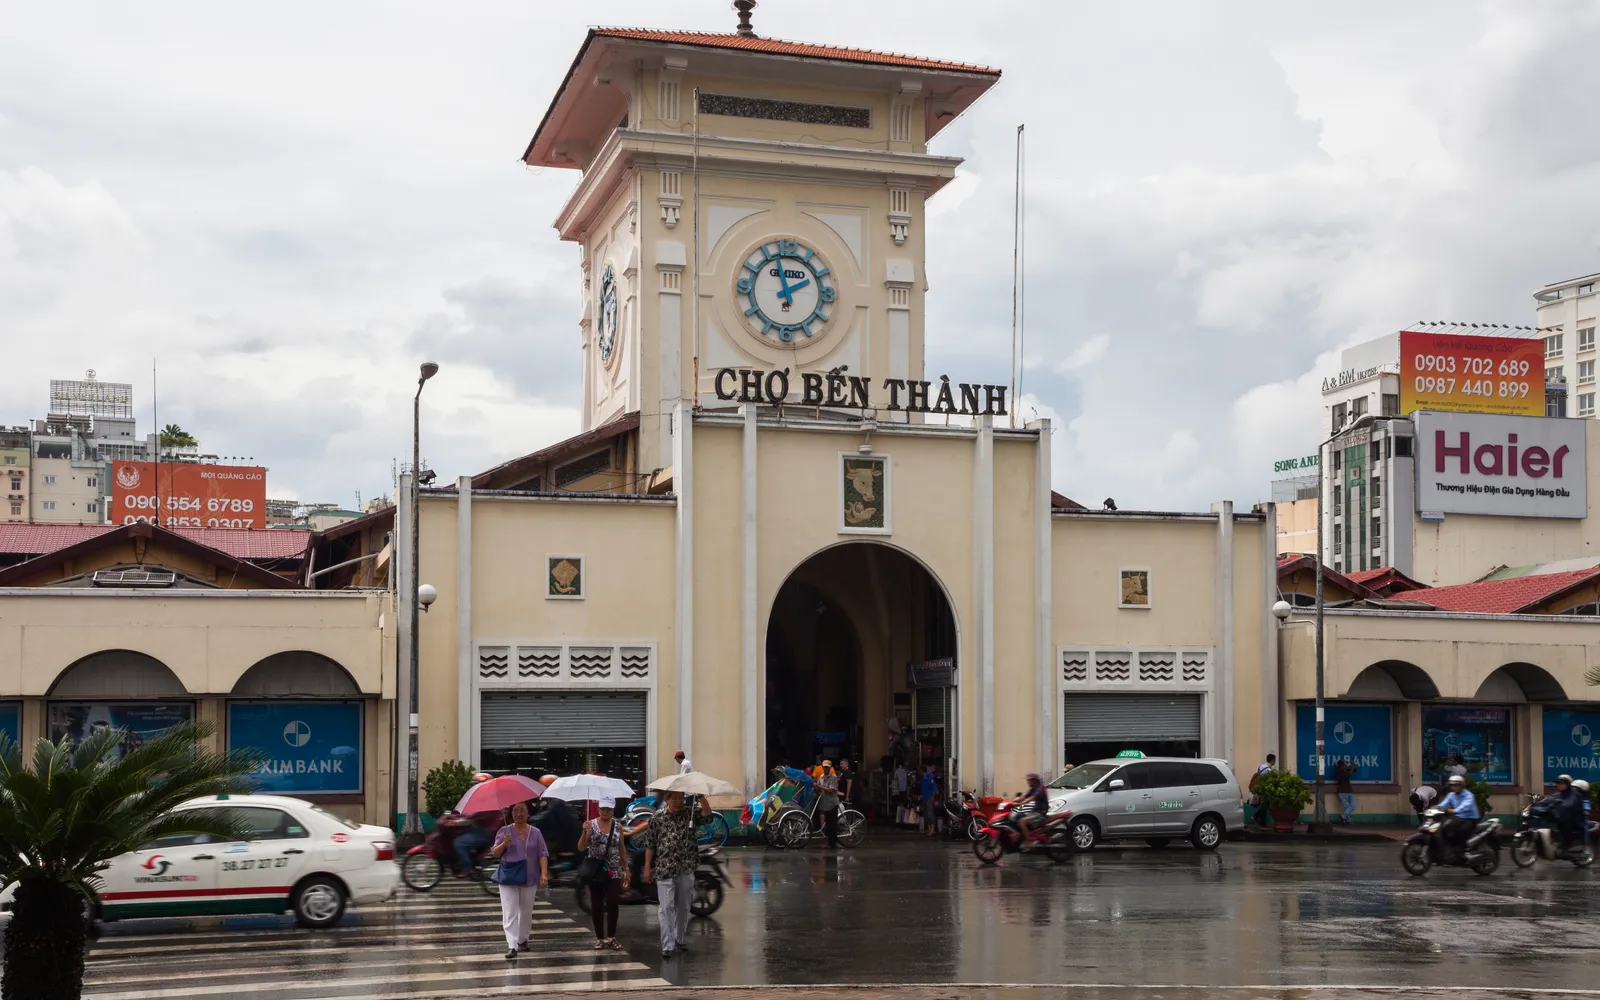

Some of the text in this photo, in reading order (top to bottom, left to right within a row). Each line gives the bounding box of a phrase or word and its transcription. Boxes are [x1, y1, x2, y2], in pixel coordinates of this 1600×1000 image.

[776, 240, 799, 257] 12
[737, 277, 752, 294] 9
[820, 285, 836, 303] 3
[779, 325, 794, 342] 6
[1415, 354, 1530, 377] 0903 702 689
[714, 365, 1008, 416] CHỢ BẾN THÀNH
[1321, 376, 1330, 391] A
[1330, 377, 1337, 388] &
[1415, 376, 1530, 399] 0987 440 899
[1435, 430, 1570, 479] Haier
[1274, 458, 1298, 472] SONG
[1436, 482, 1570, 498] Thương Hiệu Điện Gia Dụng Hàng Đầu
[125, 494, 254, 513] 090 554 6789
[1308, 754, 1380, 767] EIMBANK
[1547, 755, 1600, 769] EXIMBA
[257, 857, 273, 869] 27
[274, 856, 290, 868] 27
